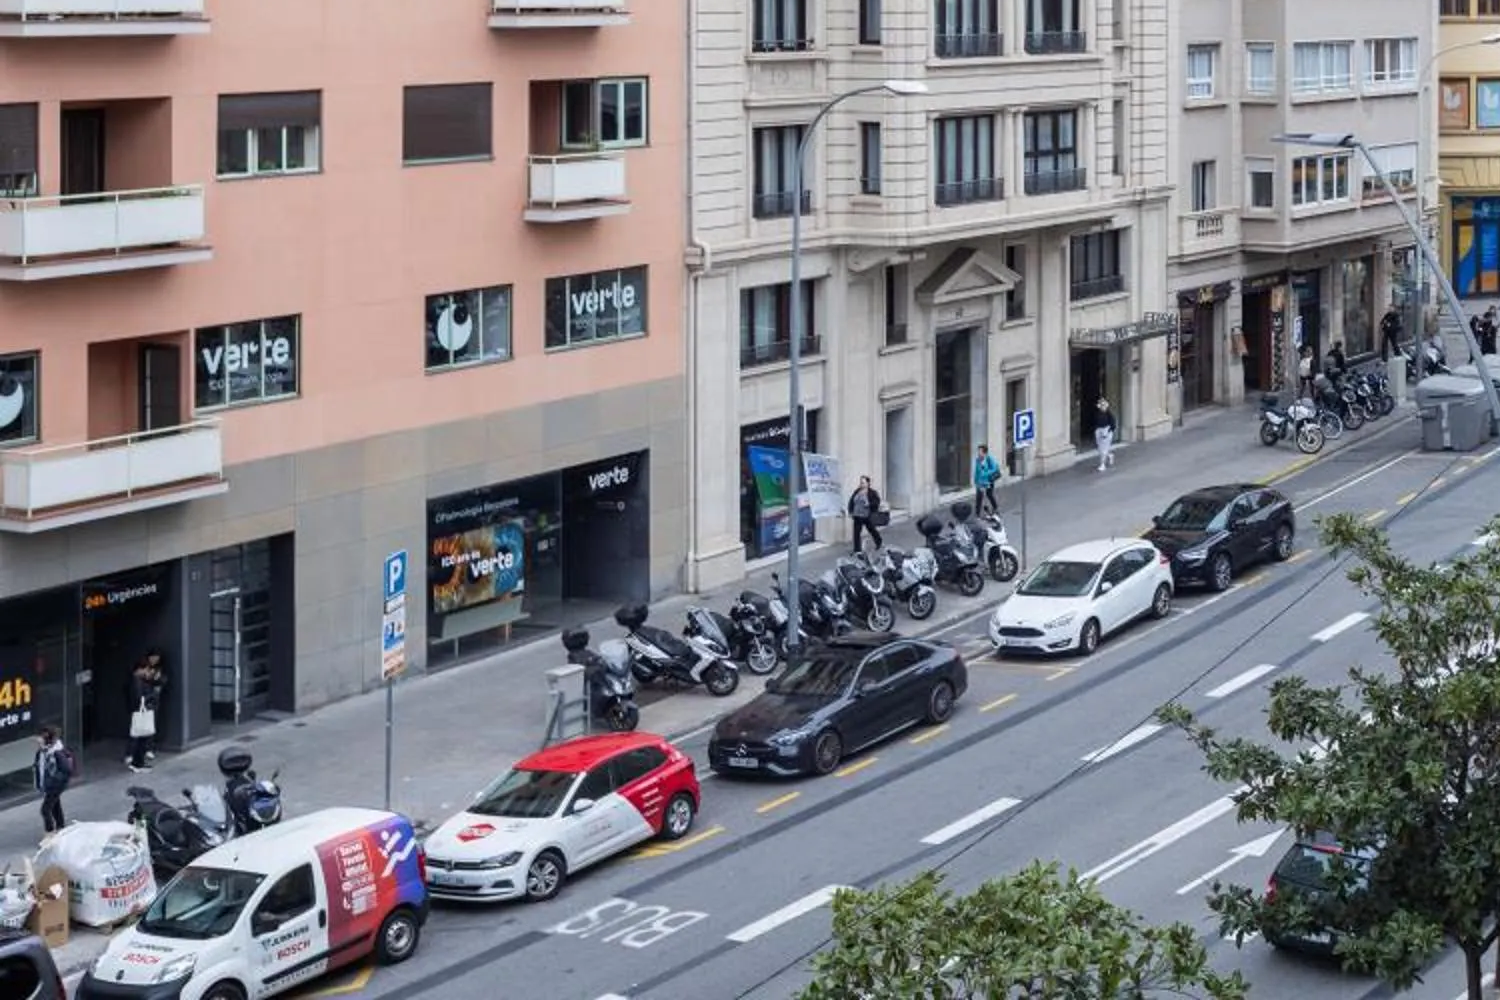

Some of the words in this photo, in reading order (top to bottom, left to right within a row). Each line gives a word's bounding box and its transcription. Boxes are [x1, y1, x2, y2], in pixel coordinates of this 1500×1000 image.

[571, 282, 635, 315] verte
[202, 337, 290, 374] verte
[1019, 415, 1032, 439] P
[588, 466, 629, 491] verte
[390, 559, 402, 592] P
[471, 552, 514, 578] verte
[0, 676, 31, 709] 4h
[556, 897, 709, 948] BUS
[277, 940, 311, 959] BOSCH
